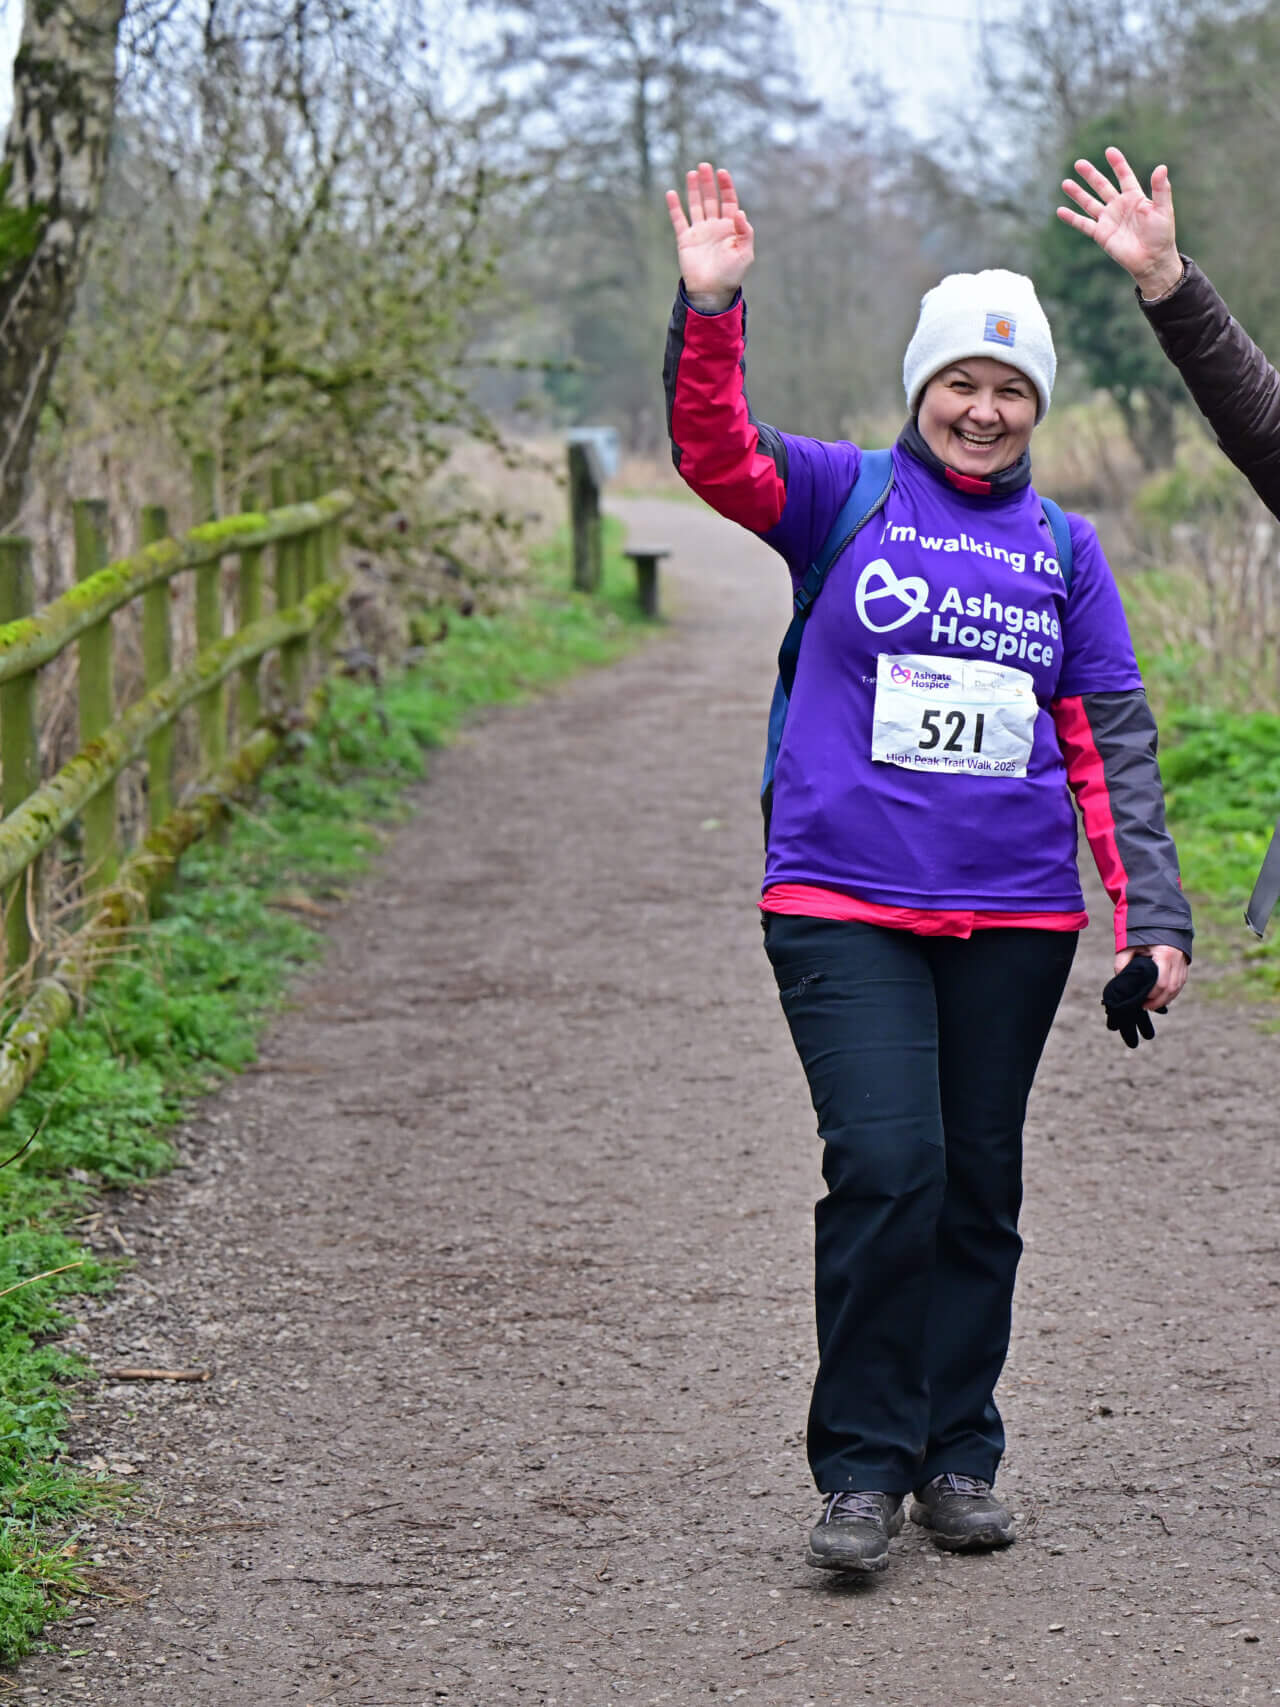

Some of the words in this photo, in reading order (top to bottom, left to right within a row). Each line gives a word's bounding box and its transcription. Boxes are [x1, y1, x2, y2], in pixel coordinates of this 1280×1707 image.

[919, 534, 1026, 572] walking
[1033, 551, 1064, 578] fo
[938, 588, 1060, 640] Ashgate
[930, 615, 1054, 667] Hospice
[911, 680, 950, 689] Hospice
[913, 671, 952, 682] Ashgate
[918, 709, 985, 753] 521
[886, 753, 912, 764] High
[914, 755, 940, 766] Peak
[943, 757, 964, 768] Trail
[967, 759, 992, 770] Walk
[994, 761, 1017, 772] 2025
